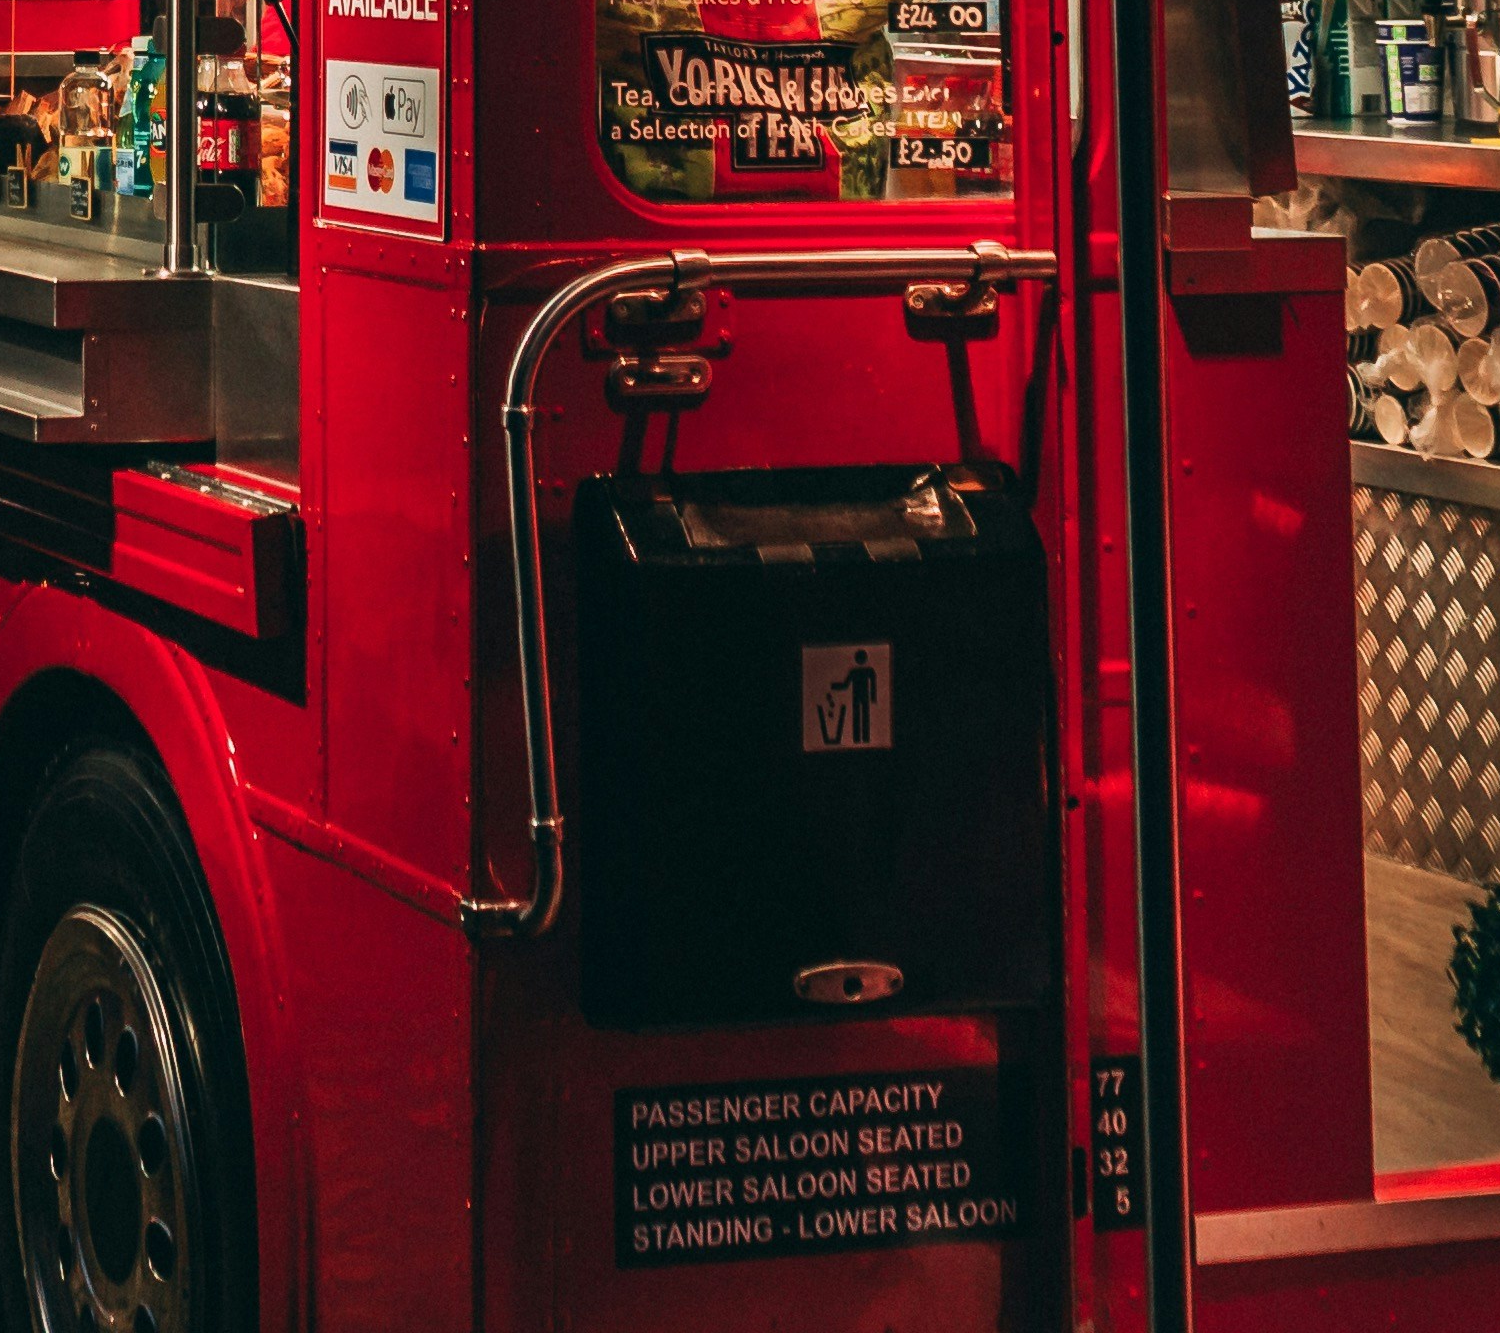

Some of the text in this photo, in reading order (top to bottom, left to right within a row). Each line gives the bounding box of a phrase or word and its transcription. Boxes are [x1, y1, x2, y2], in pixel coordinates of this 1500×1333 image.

[611, 82, 660, 109] Tea,
[810, 80, 898, 105] Scones
[397, 87, 421, 133] Pay
[611, 125, 622, 140] a
[629, 118, 731, 141] Selection
[737, 118, 761, 139] of
[832, 116, 898, 138] Cakes
[741, 112, 815, 159] TEA
[333, 154, 354, 176] VISA
[1096, 1068, 1126, 1097] 77
[632, 1082, 943, 1130] PASSENGER CAPACITY
[1098, 1108, 1127, 1138] 40
[632, 1121, 963, 1171] UPPER SALOON SEATED
[1099, 1148, 1129, 1178] 32
[632, 1161, 971, 1212] LOWER SALOON SEATED
[1115, 1186, 1131, 1216] 5
[632, 1196, 1019, 1253] STANDING LOWER SALOON
